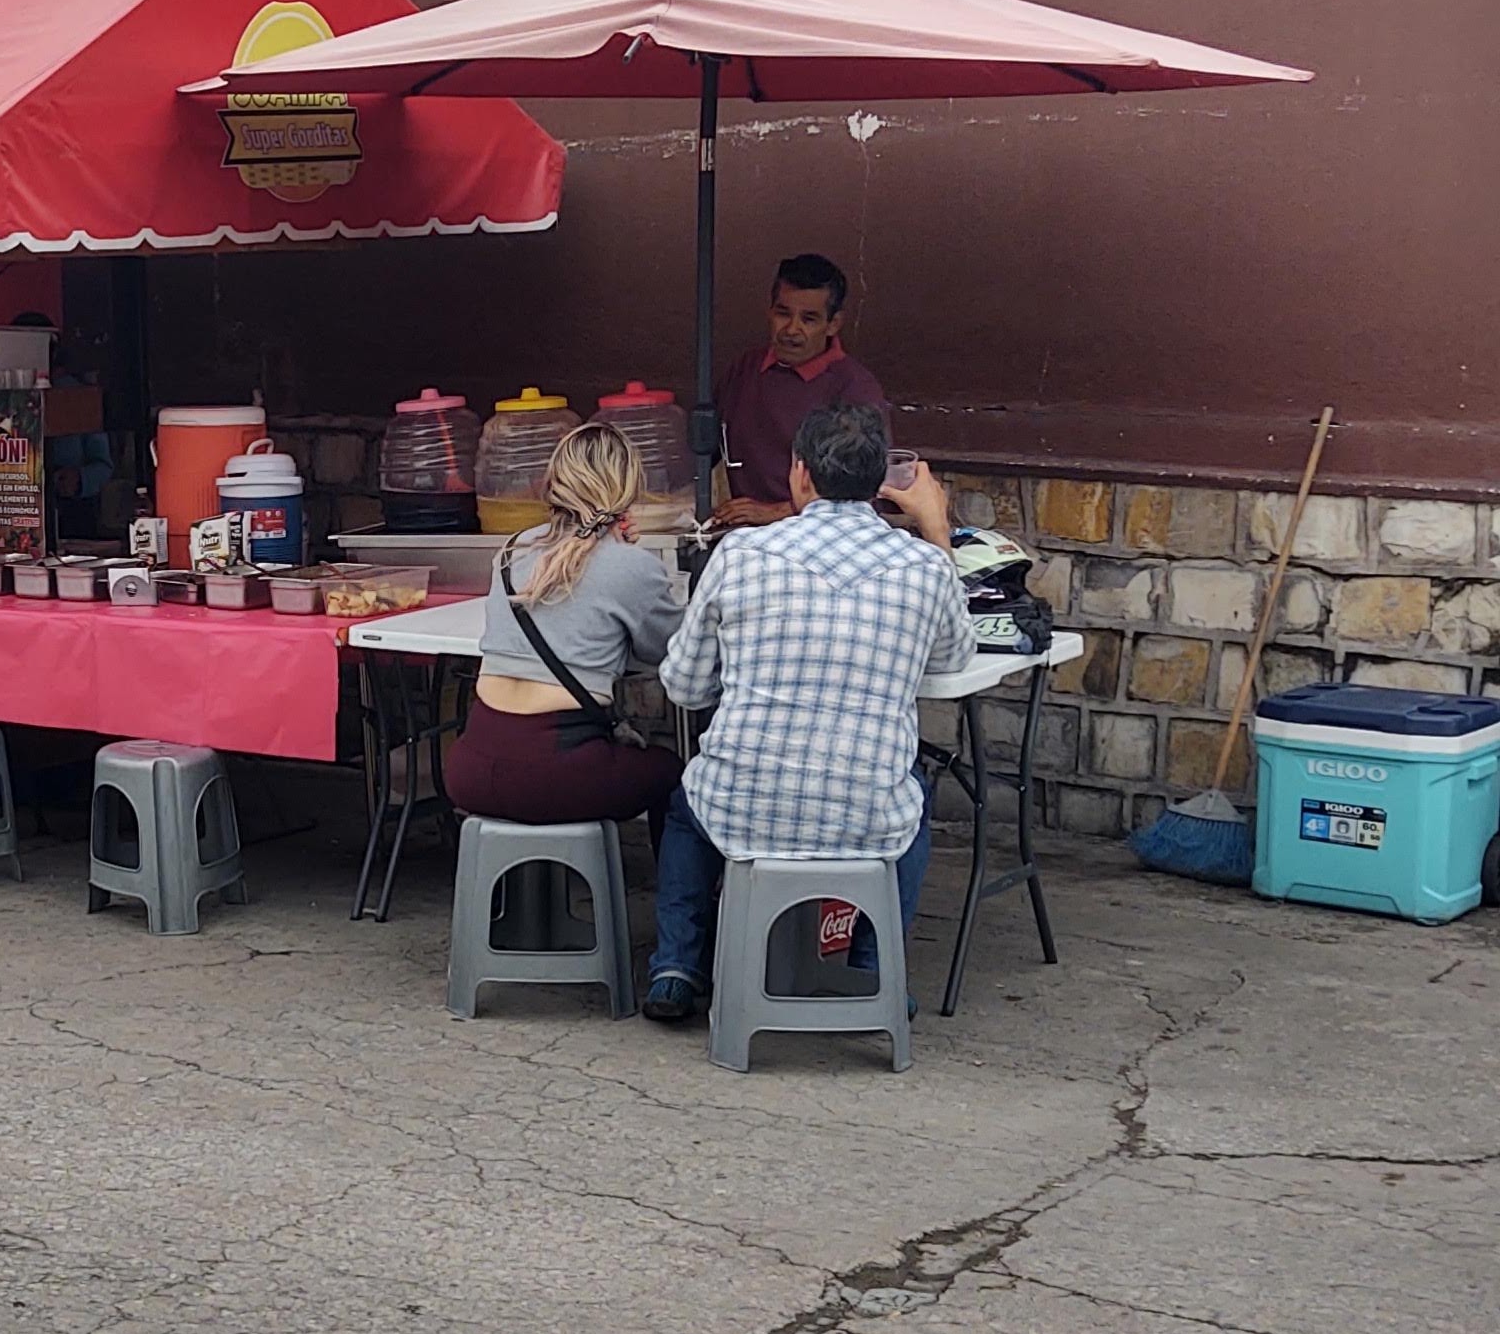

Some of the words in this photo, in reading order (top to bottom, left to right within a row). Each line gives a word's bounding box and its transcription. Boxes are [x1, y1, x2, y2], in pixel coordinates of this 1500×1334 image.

[241, 123, 285, 154] Super
[286, 121, 349, 148] Gorditas
[974, 616, 1019, 637] 46
[1306, 759, 1388, 782] IGLOO
[1324, 802, 1364, 815] IGLOO
